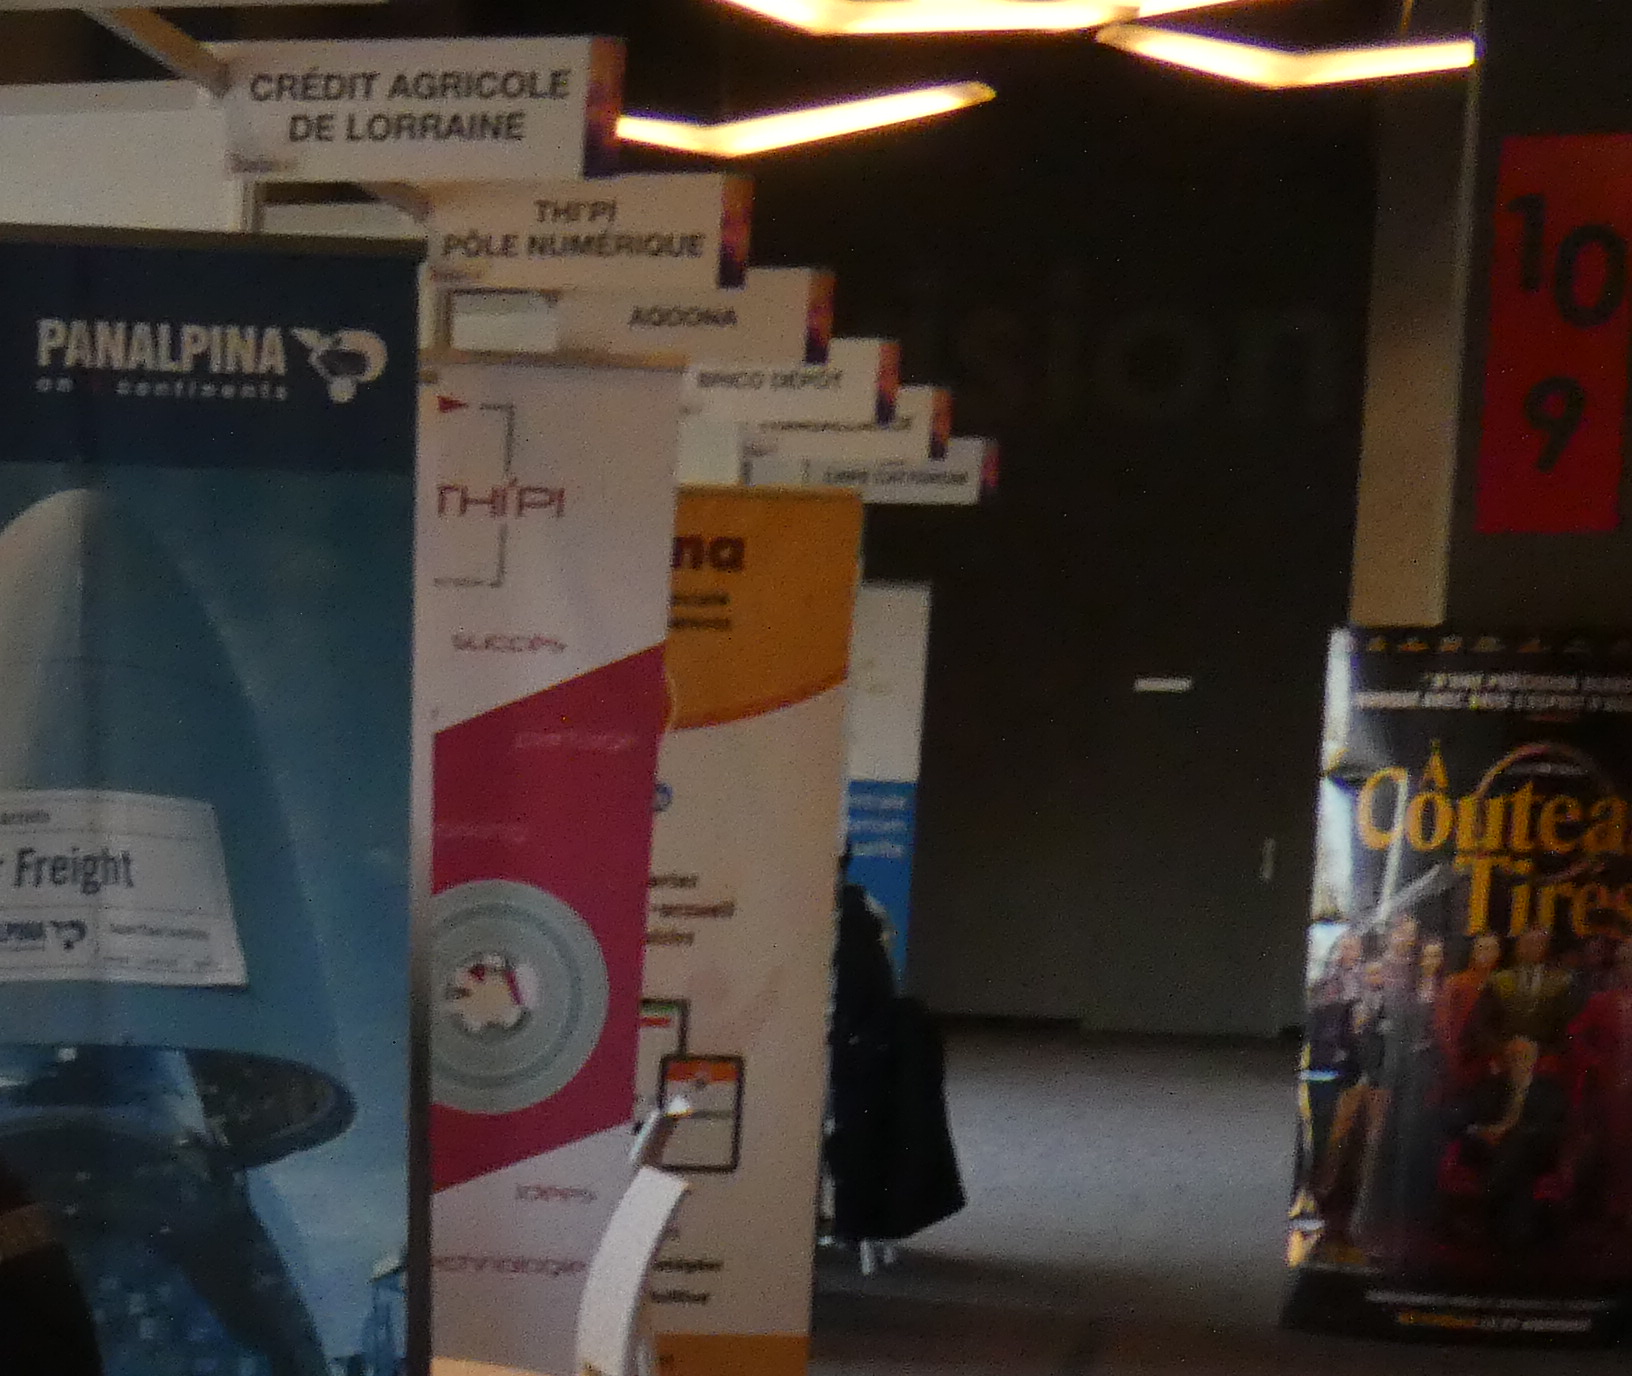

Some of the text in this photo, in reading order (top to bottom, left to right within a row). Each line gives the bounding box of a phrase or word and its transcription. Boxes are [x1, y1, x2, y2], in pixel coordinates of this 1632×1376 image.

[249, 66, 572, 101] CRÉDIT AGRICOLE
[289, 111, 527, 142] DE LORRAINE
[441, 229, 705, 257] PÔLE NUMÉRIQUE
[1506, 193, 1627, 329] 10
[35, 317, 288, 377] PANALPINA
[1523, 375, 1586, 473] 9
[14, 845, 135, 895] Freight
